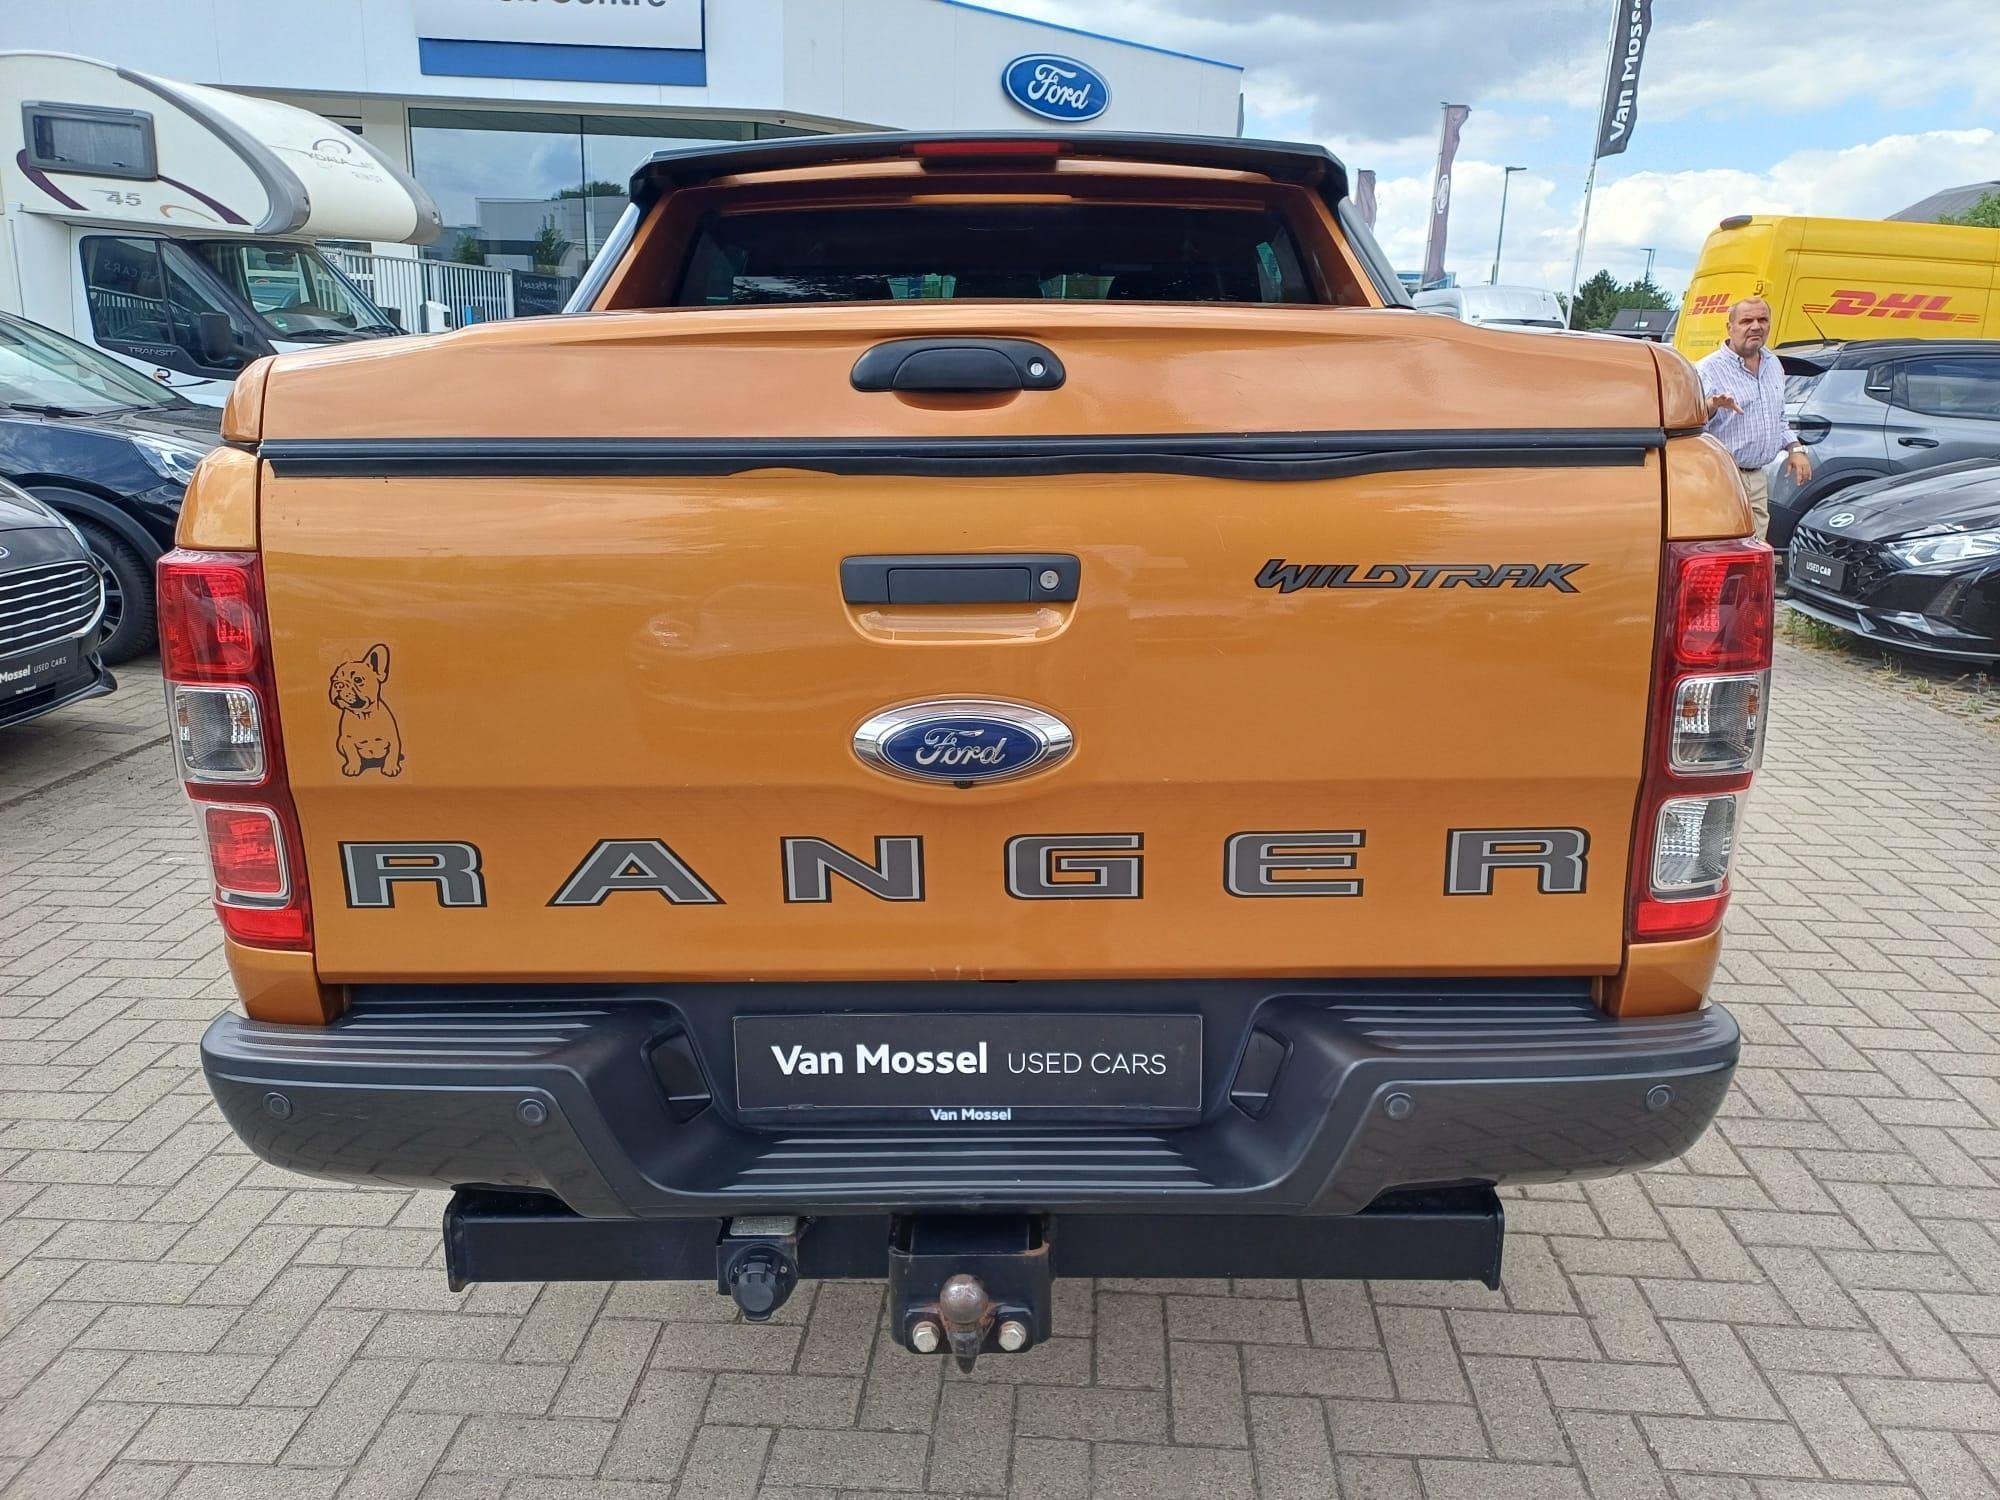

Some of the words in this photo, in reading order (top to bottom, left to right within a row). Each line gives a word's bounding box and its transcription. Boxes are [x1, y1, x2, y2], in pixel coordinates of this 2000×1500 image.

[1027, 63, 1092, 110] Ford
[1610, 89, 1634, 142] Van
[106, 190, 142, 207] 45
[1691, 293, 1730, 316] DHL
[1826, 289, 1956, 322] DHL
[128, 346, 177, 356] TRANSIT
[1254, 558, 1590, 594] WILDTRAK
[1806, 561, 1820, 572] USED
[1820, 566, 1831, 576] CAR
[0, 664, 30, 683] Mossel
[33, 663, 49, 673] USED
[51, 656, 67, 667] CARS
[915, 727, 1007, 766] Ford
[337, 827, 1589, 909] RANGER
[771, 1045, 844, 1075] Van
[856, 1041, 988, 1075] Mossel
[1008, 1052, 1082, 1074] USED
[1091, 1053, 1168, 1075] CARS
[930, 1109, 958, 1121] Van
[961, 1108, 1012, 1121] Mossel
